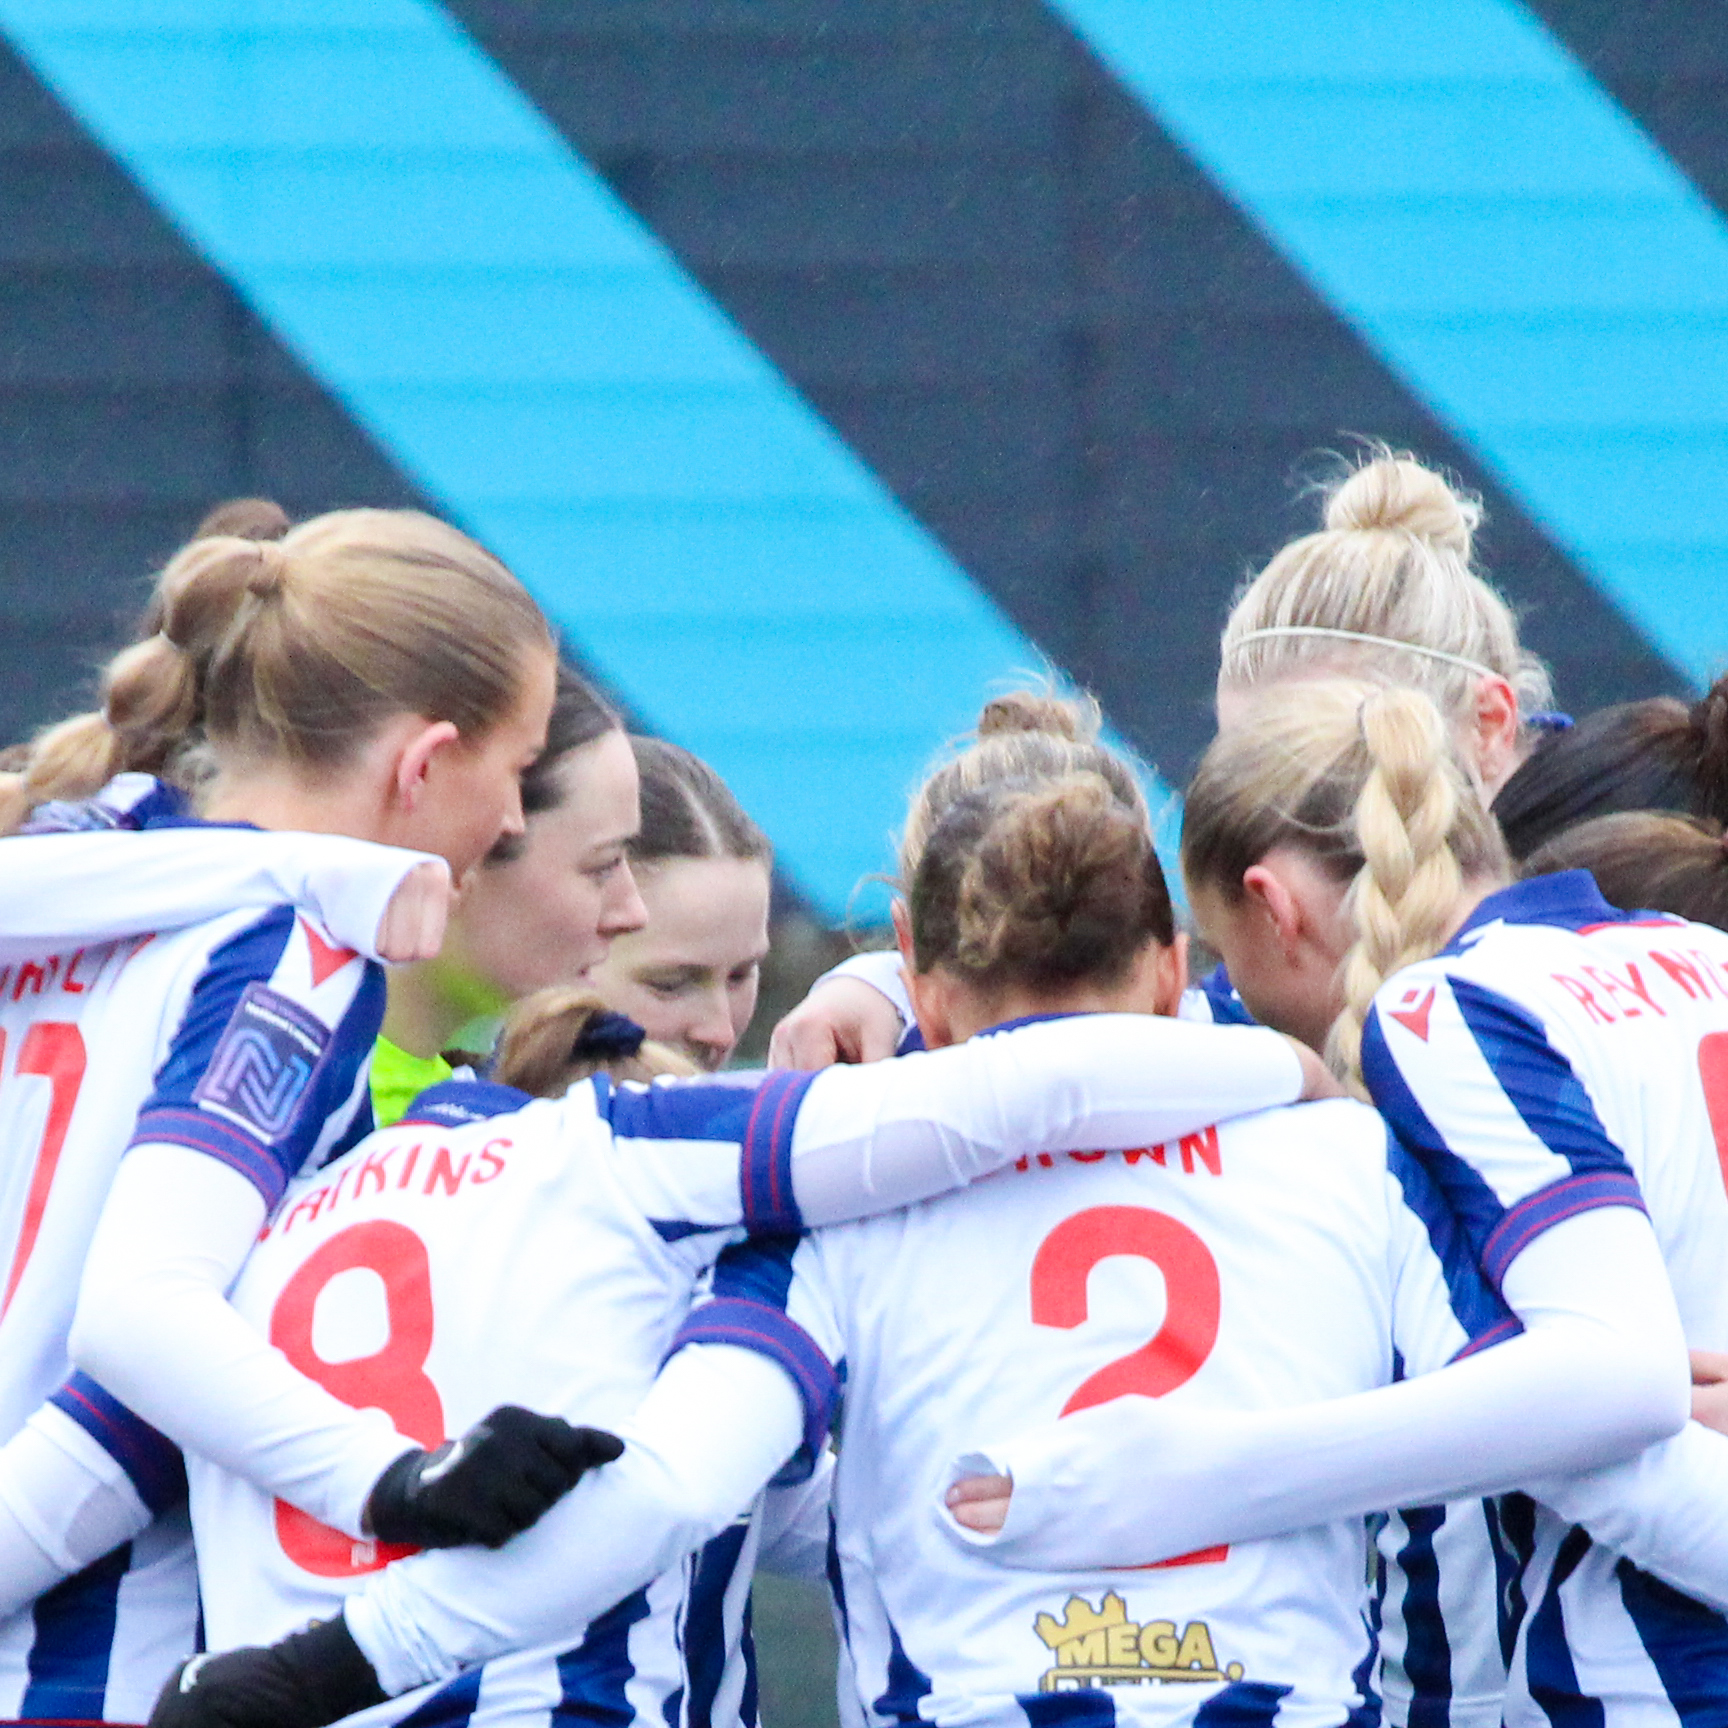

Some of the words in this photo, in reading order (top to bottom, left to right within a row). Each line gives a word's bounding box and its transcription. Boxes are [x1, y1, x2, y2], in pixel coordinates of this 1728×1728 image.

[257, 1137, 515, 1243] ATKINS
[270, 1218, 446, 1578] 8
[1029, 1204, 1230, 1570] 2
[1055, 1618, 1219, 1671] MEGA
